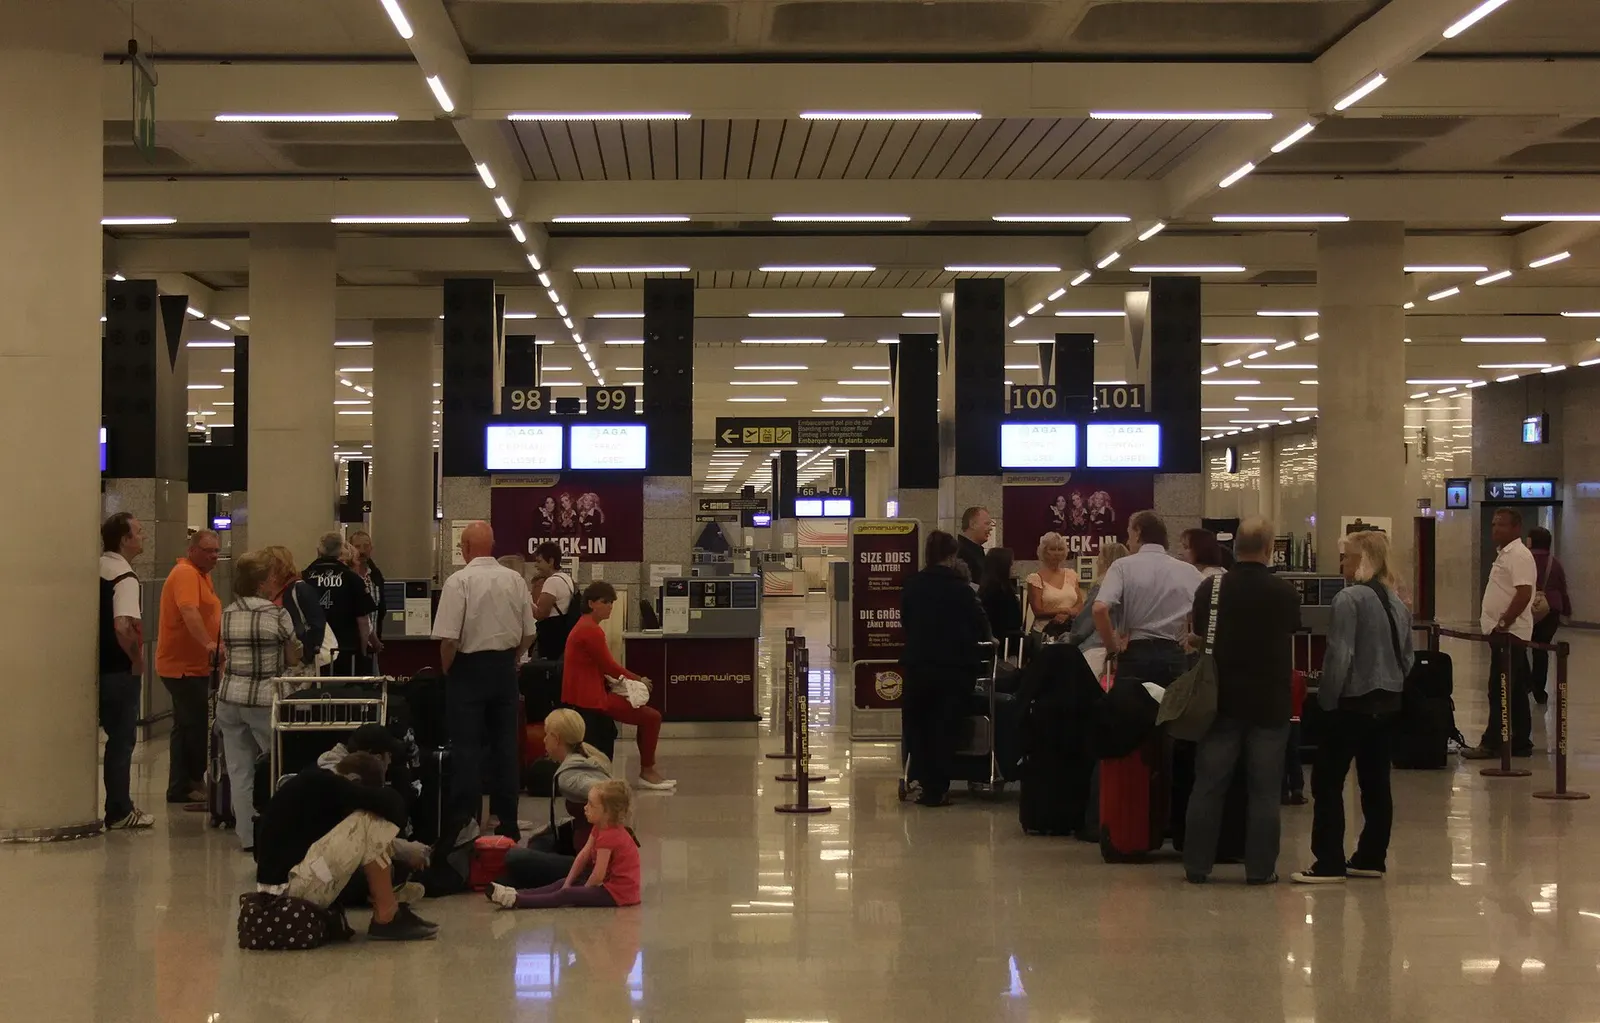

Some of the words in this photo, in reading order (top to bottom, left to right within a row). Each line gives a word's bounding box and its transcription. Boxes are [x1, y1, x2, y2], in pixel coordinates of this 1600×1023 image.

[511, 389, 541, 411] 98
[596, 389, 626, 411] 99
[1013, 388, 1057, 409] 100
[1099, 387, 1141, 409] 101
[802, 488, 814, 496] 66
[832, 488, 843, 496] 67
[857, 524, 910, 533] germanwings
[527, 537, 607, 554] CCK-IN
[860, 551, 882, 563] SIZE
[885, 551, 911, 563] DOES
[870, 564, 901, 572] MATTER!
[317, 576, 343, 588] POLO
[859, 609, 875, 620] DIE
[876, 607, 901, 620] GRÖS
[670, 672, 752, 684] germanwings
[1558, 682, 1568, 756] germanwings
[798, 695, 808, 774] germanwings
